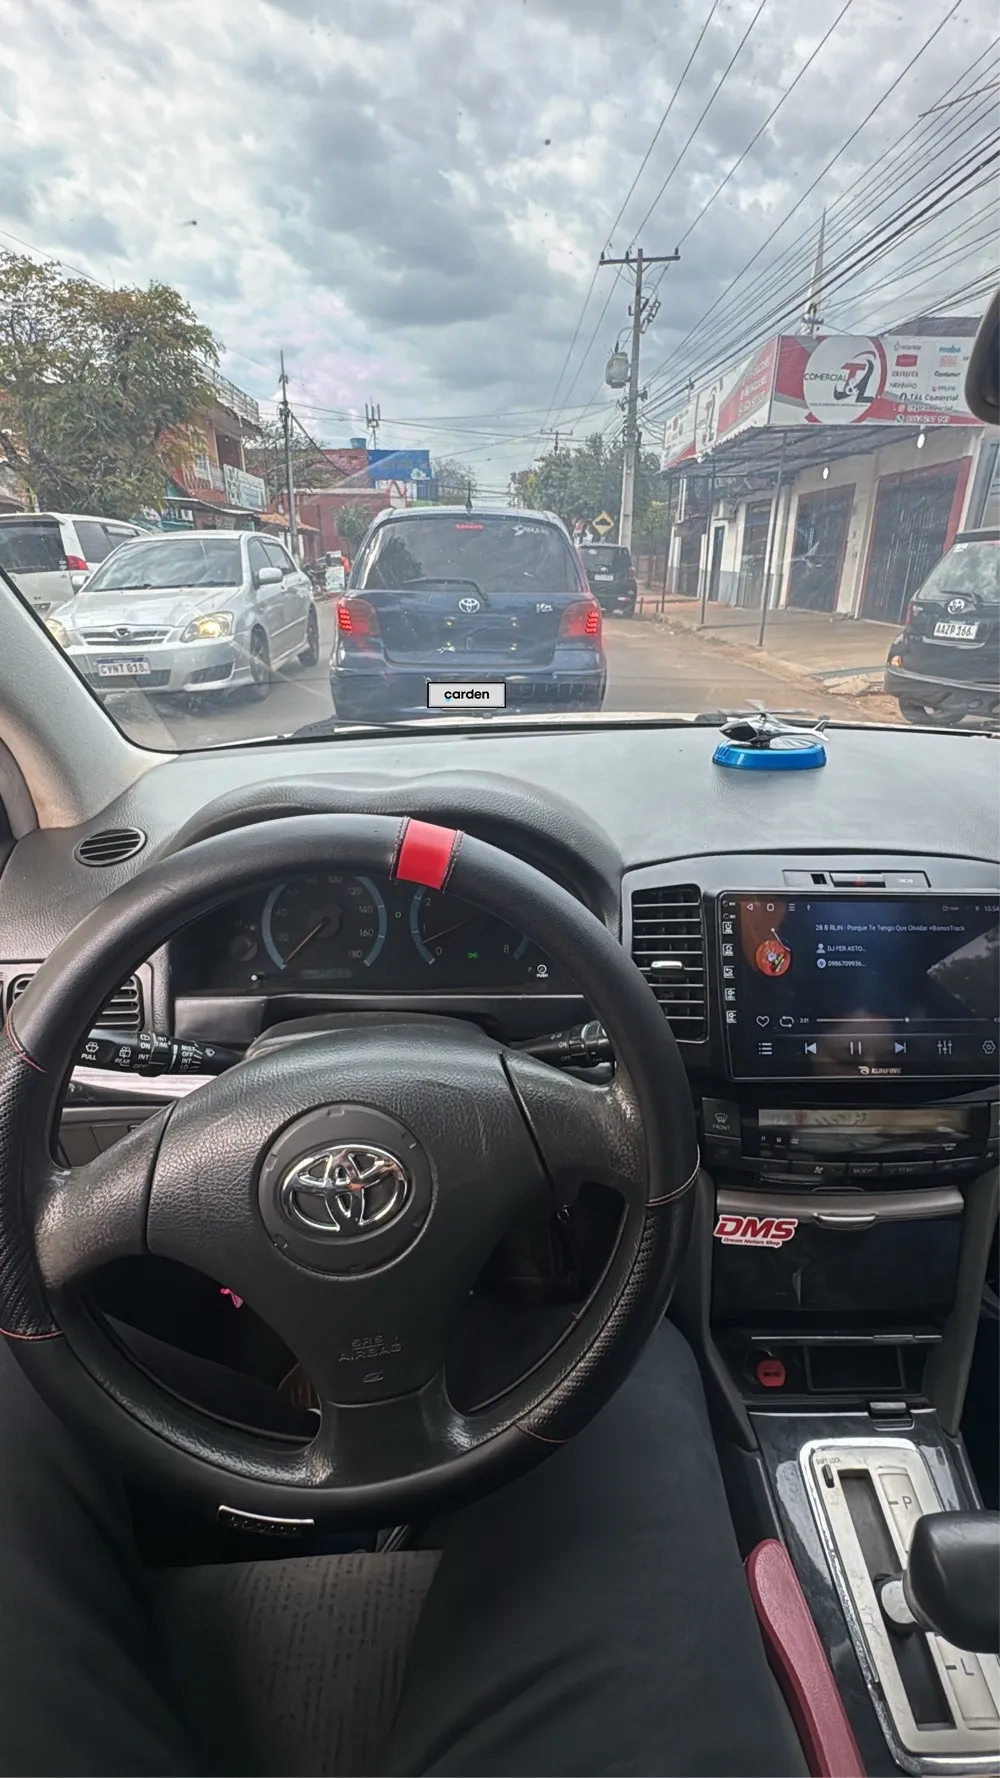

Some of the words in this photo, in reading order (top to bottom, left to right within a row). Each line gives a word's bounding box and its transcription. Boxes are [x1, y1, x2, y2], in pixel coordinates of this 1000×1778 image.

[803, 373, 847, 382] COMERCIAL
[936, 624, 956, 635] AAZP
[955, 626, 972, 637] 166
[425, 897, 432, 907] 2
[275, 907, 288, 916] 40
[358, 905, 374, 914] 140
[277, 933, 289, 941] 20
[359, 929, 374, 937] 160
[348, 949, 363, 959] 180
[435, 946, 442, 955] 0
[503, 944, 510, 954] 8
[140, 1042, 150, 1050] ON
[715, 1217, 797, 1239] DMS
[338, 1343, 402, 1362] AIRBAG
[901, 1495, 913, 1511] P
[960, 1657, 975, 1676] L
